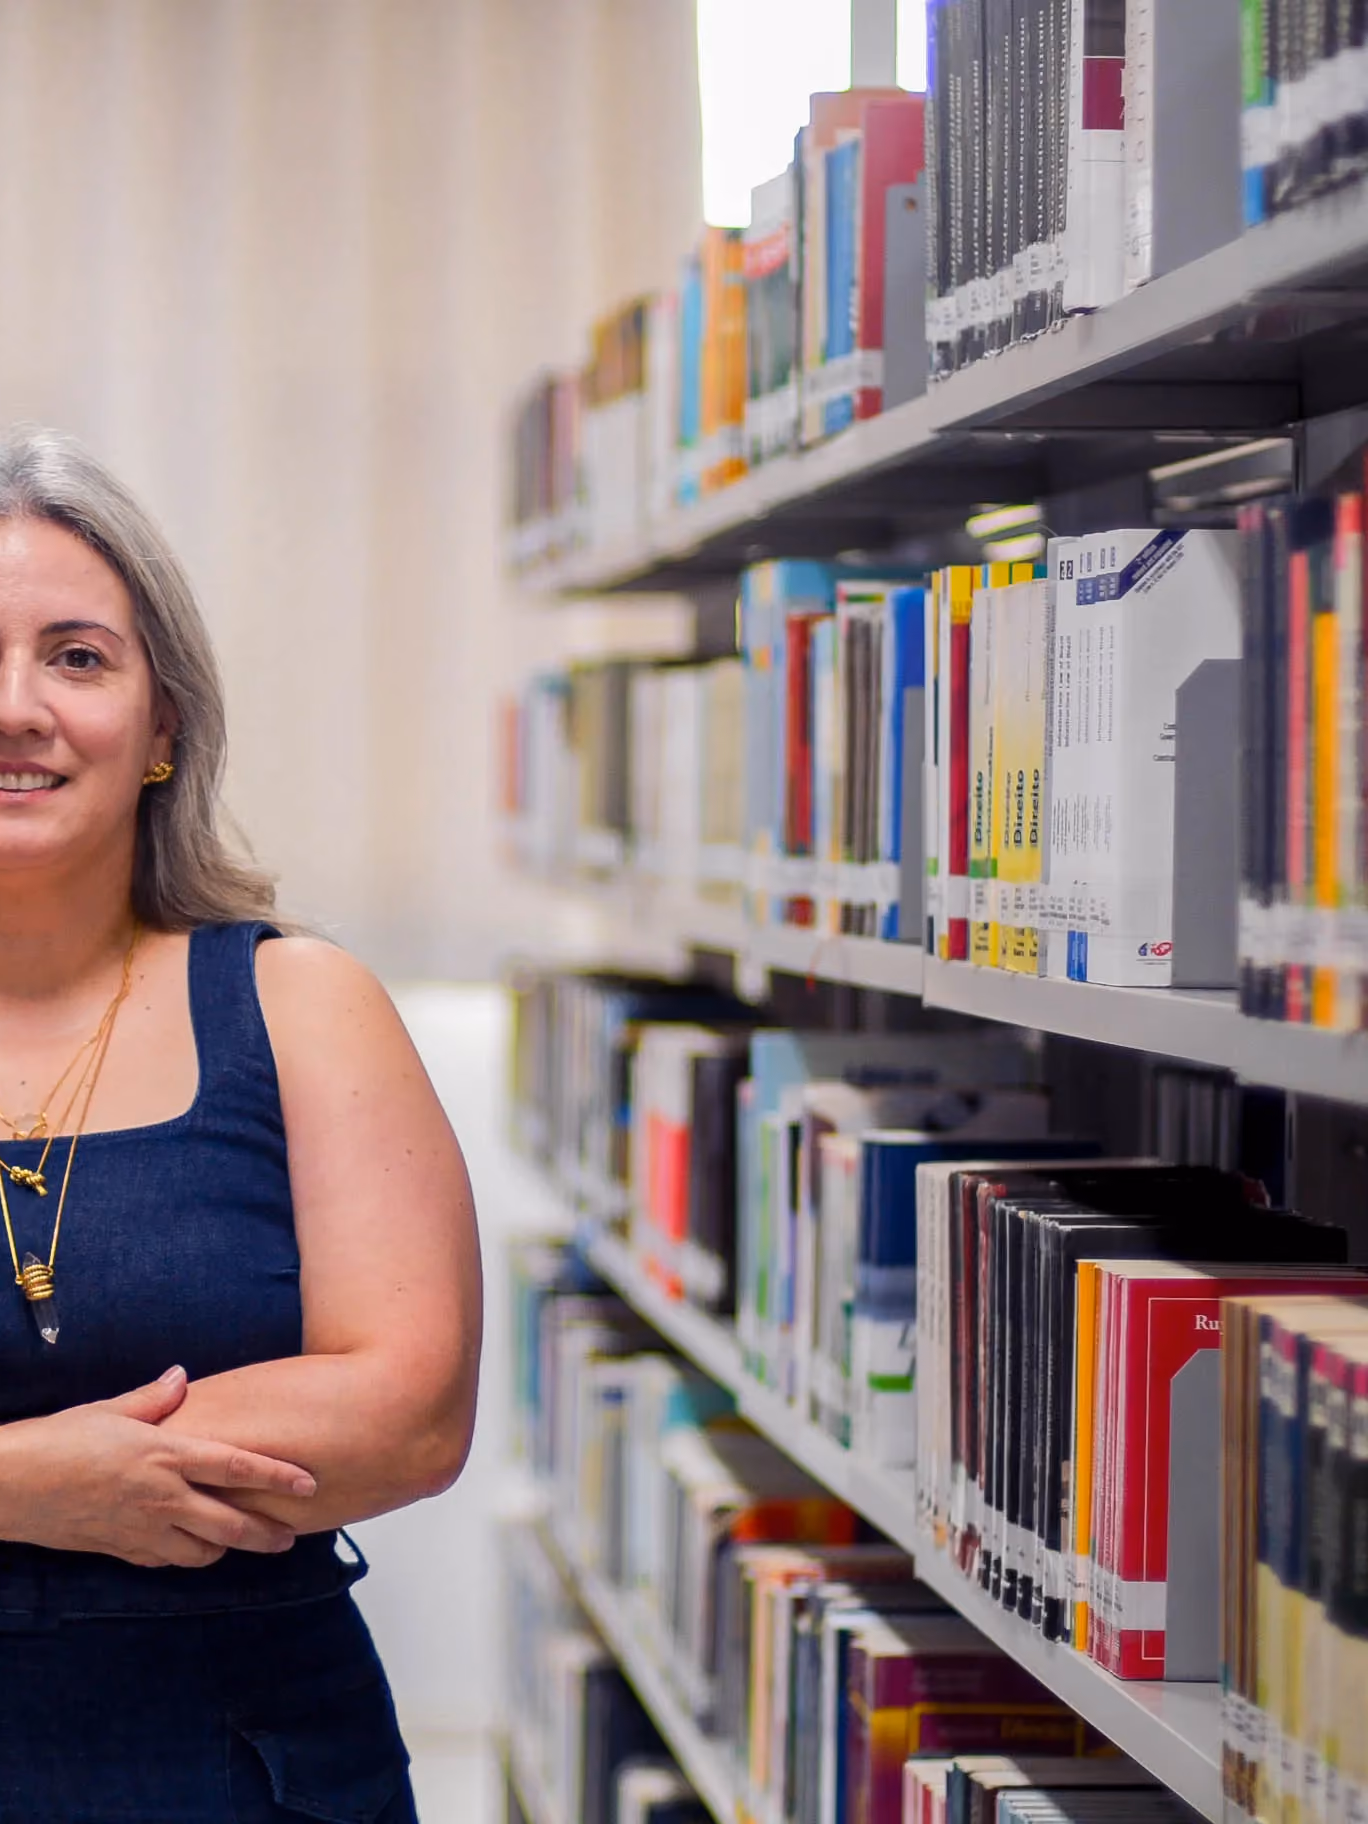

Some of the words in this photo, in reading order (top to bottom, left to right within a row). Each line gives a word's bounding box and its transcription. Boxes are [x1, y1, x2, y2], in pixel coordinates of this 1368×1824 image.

[1036, 9, 1044, 85] DIREITO
[974, 770, 983, 843] Direito
[1013, 769, 1024, 844] Direito
[1029, 768, 1040, 844] Direito
[1193, 1313, 1224, 1336] Ru
